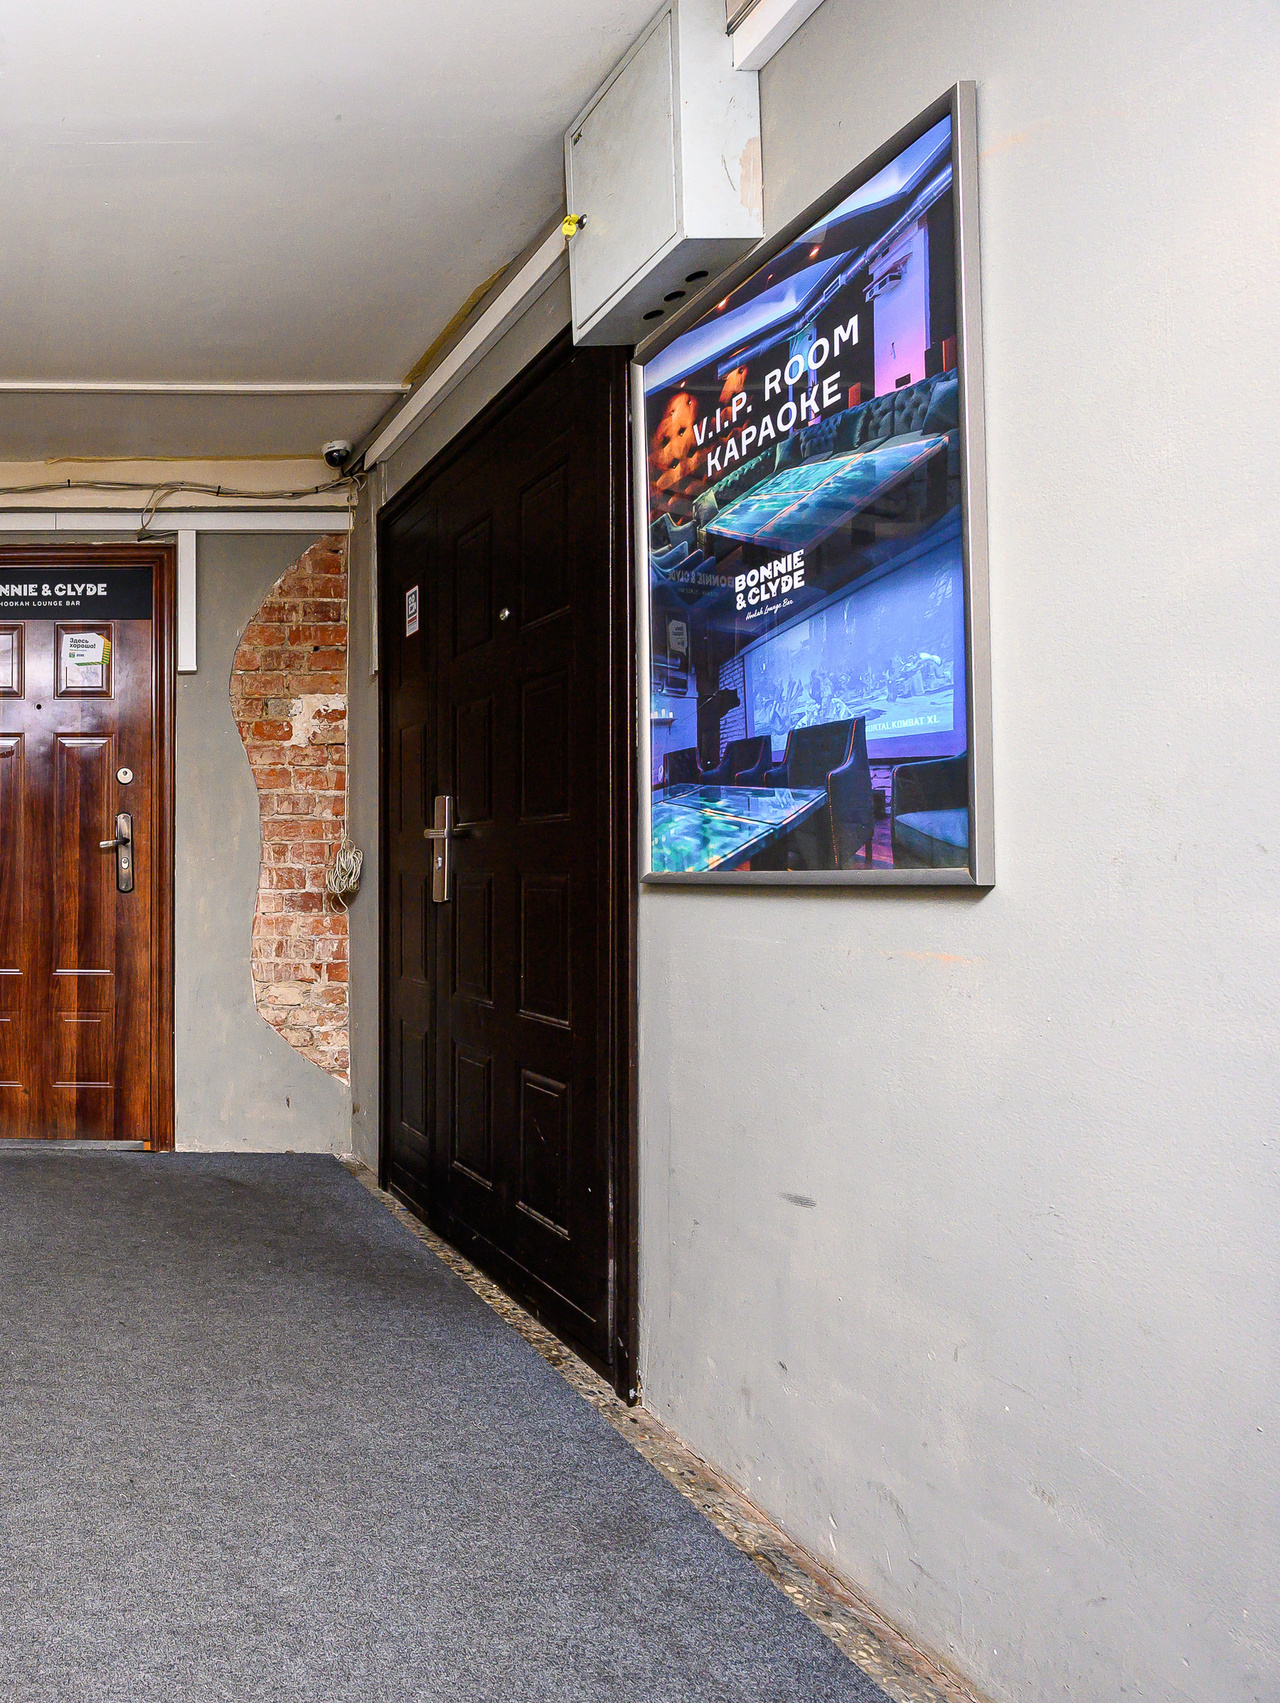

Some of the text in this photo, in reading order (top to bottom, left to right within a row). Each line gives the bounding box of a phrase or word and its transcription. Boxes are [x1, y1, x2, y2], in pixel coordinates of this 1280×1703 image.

[692, 314, 860, 447] V.I.P. ROOM
[706, 371, 842, 478] КАРАОКЕ
[41, 583, 52, 596] &
[54, 583, 108, 596] CLYDE
[734, 548, 805, 593] BONNIE
[892, 717, 925, 729] KOMBAT
[926, 714, 940, 724] XL
